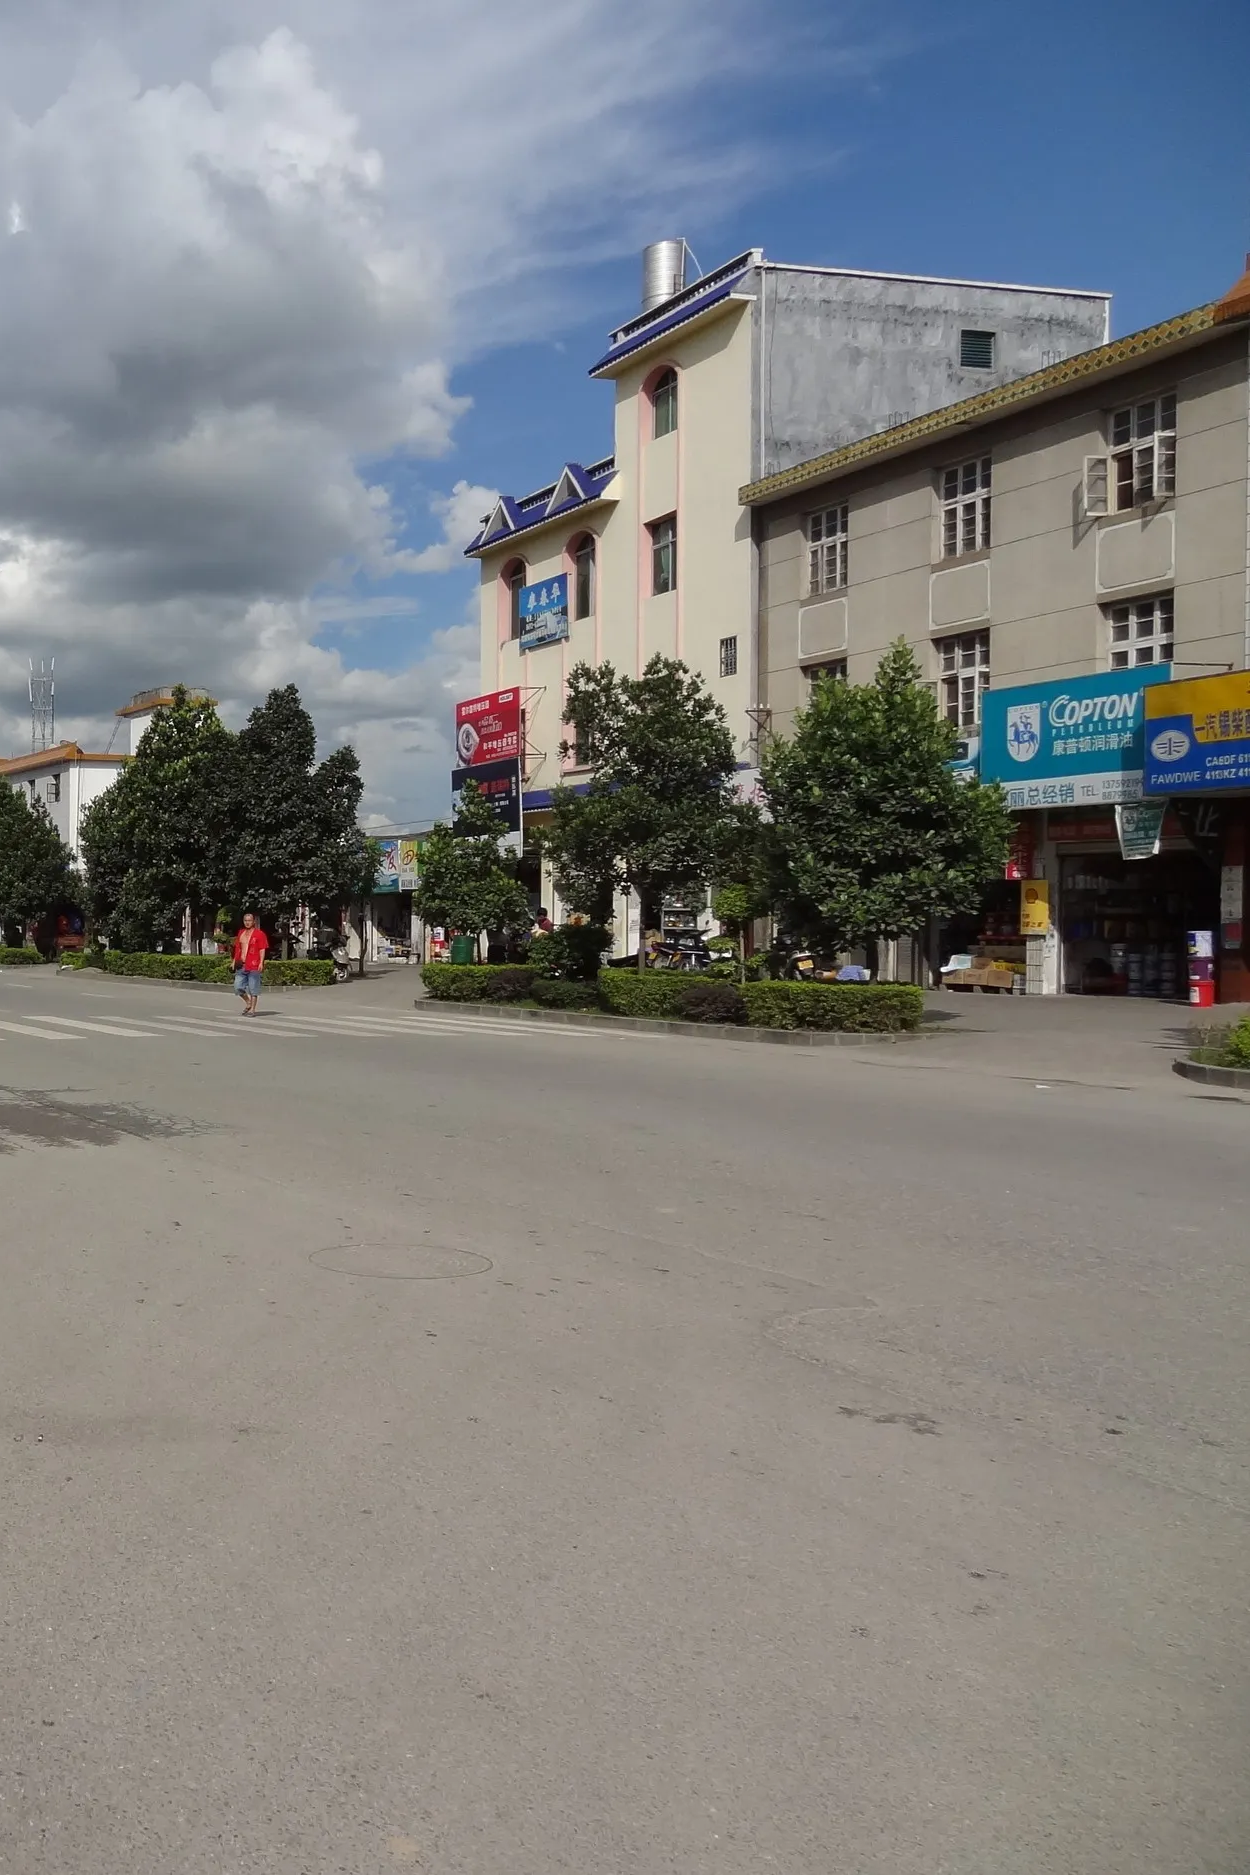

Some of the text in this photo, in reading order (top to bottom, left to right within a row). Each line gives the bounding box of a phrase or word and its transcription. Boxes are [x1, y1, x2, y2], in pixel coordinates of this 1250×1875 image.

[1049, 692, 1139, 727] COPTON
[1052, 718, 1135, 738] PETROLEUM
[1194, 708, 1250, 740] 一汽锡柴
[1052, 730, 1133, 756] 康普顿润滑油
[1151, 770, 1201, 785] FAWDWE
[1004, 782, 1076, 808] 丽总经销
